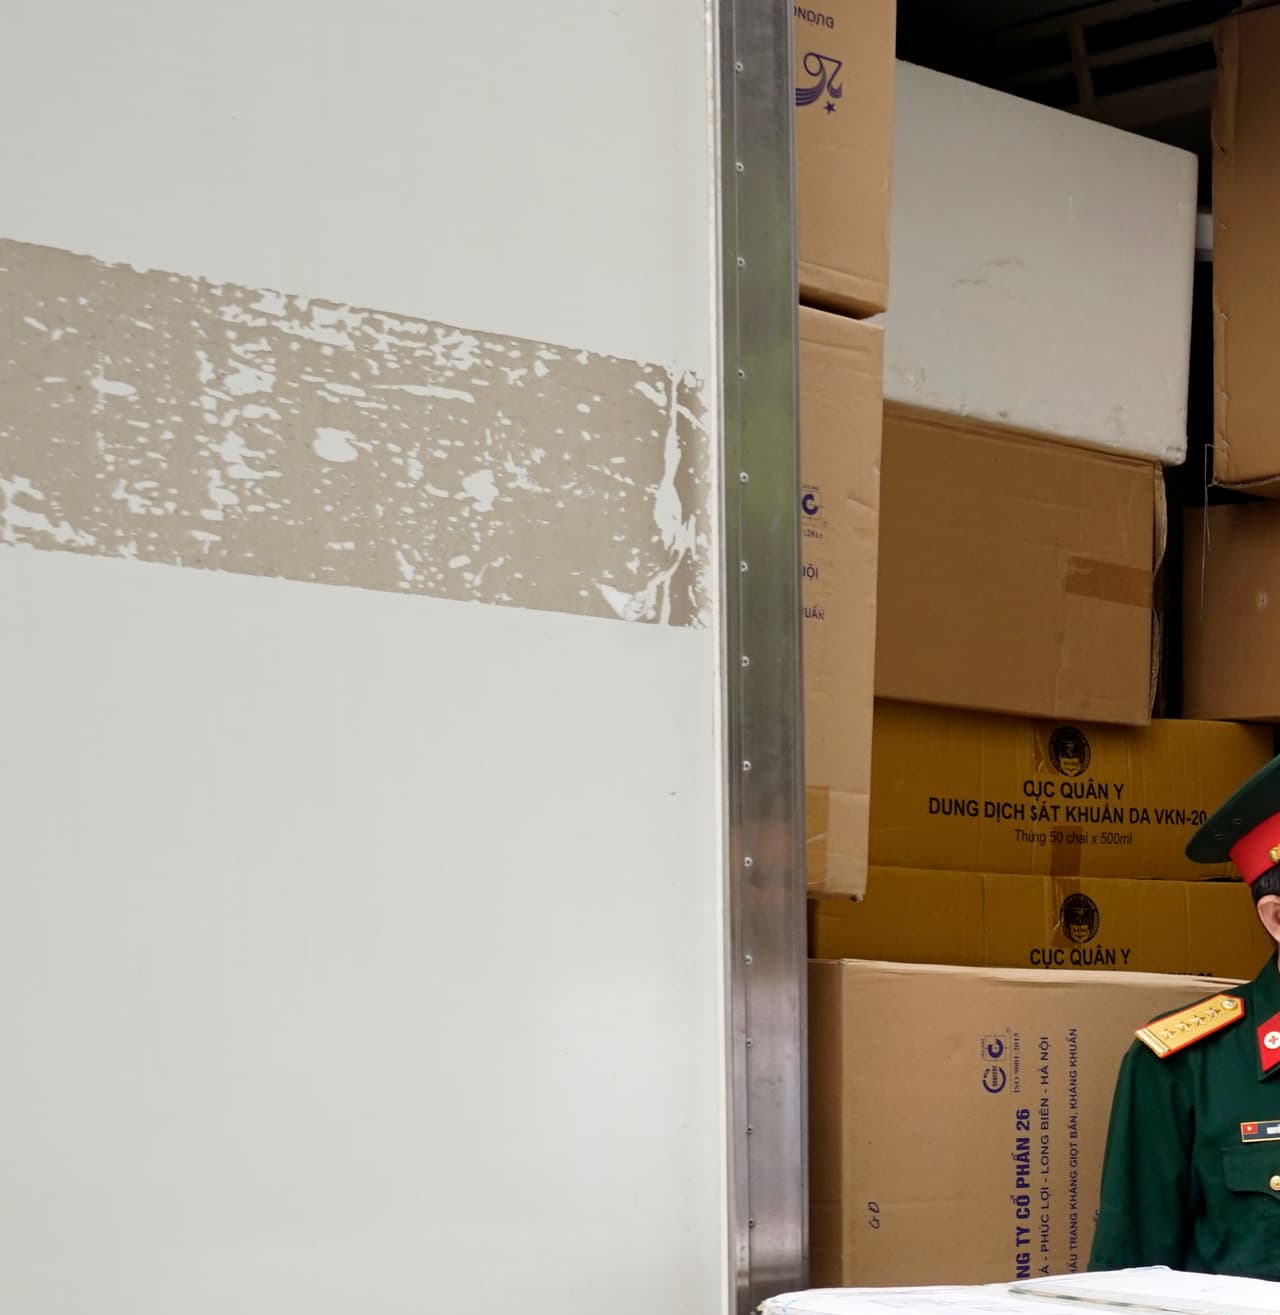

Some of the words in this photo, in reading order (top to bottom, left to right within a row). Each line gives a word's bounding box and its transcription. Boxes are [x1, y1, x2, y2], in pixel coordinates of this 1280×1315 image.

[1060, 779, 1109, 799] QUÂN
[1113, 783, 1124, 799] Y
[929, 797, 979, 817] DUNG
[984, 801, 1025, 823] DỊCH
[1129, 807, 1151, 825] DA
[1154, 808, 1208, 826] VKN-20
[1050, 831, 1063, 844] 50
[1066, 831, 1089, 845] chai
[1091, 835, 1098, 845] x
[1100, 832, 1133, 846] 500ml
[1030, 948, 1065, 970] CỤC
[1069, 945, 1116, 966] QUÂN
[1121, 949, 1131, 965] Y
[1039, 1036, 1051, 1064] NỘI
[1067, 1028, 1078, 1069] KHUẨN
[1038, 1067, 1049, 1086] HÀ
[1067, 1071, 1078, 1110] KHÁNG
[1016, 1108, 1030, 1131] 26
[1038, 1097, 1049, 1130] BIÊN
[1011, 1137, 1030, 1188] PHẦN
[1040, 1134, 1049, 1174] LONG
[1069, 1140, 1079, 1169] GIỌT
[1039, 1187, 1051, 1208] LỢI
[1067, 1171, 1078, 1210] KHÁNG
[1011, 1195, 1030, 1219] CỔ
[1016, 1225, 1030, 1246] TY
[1038, 1211, 1049, 1253] PHÚC
[1069, 1211, 1078, 1246] TRANG
